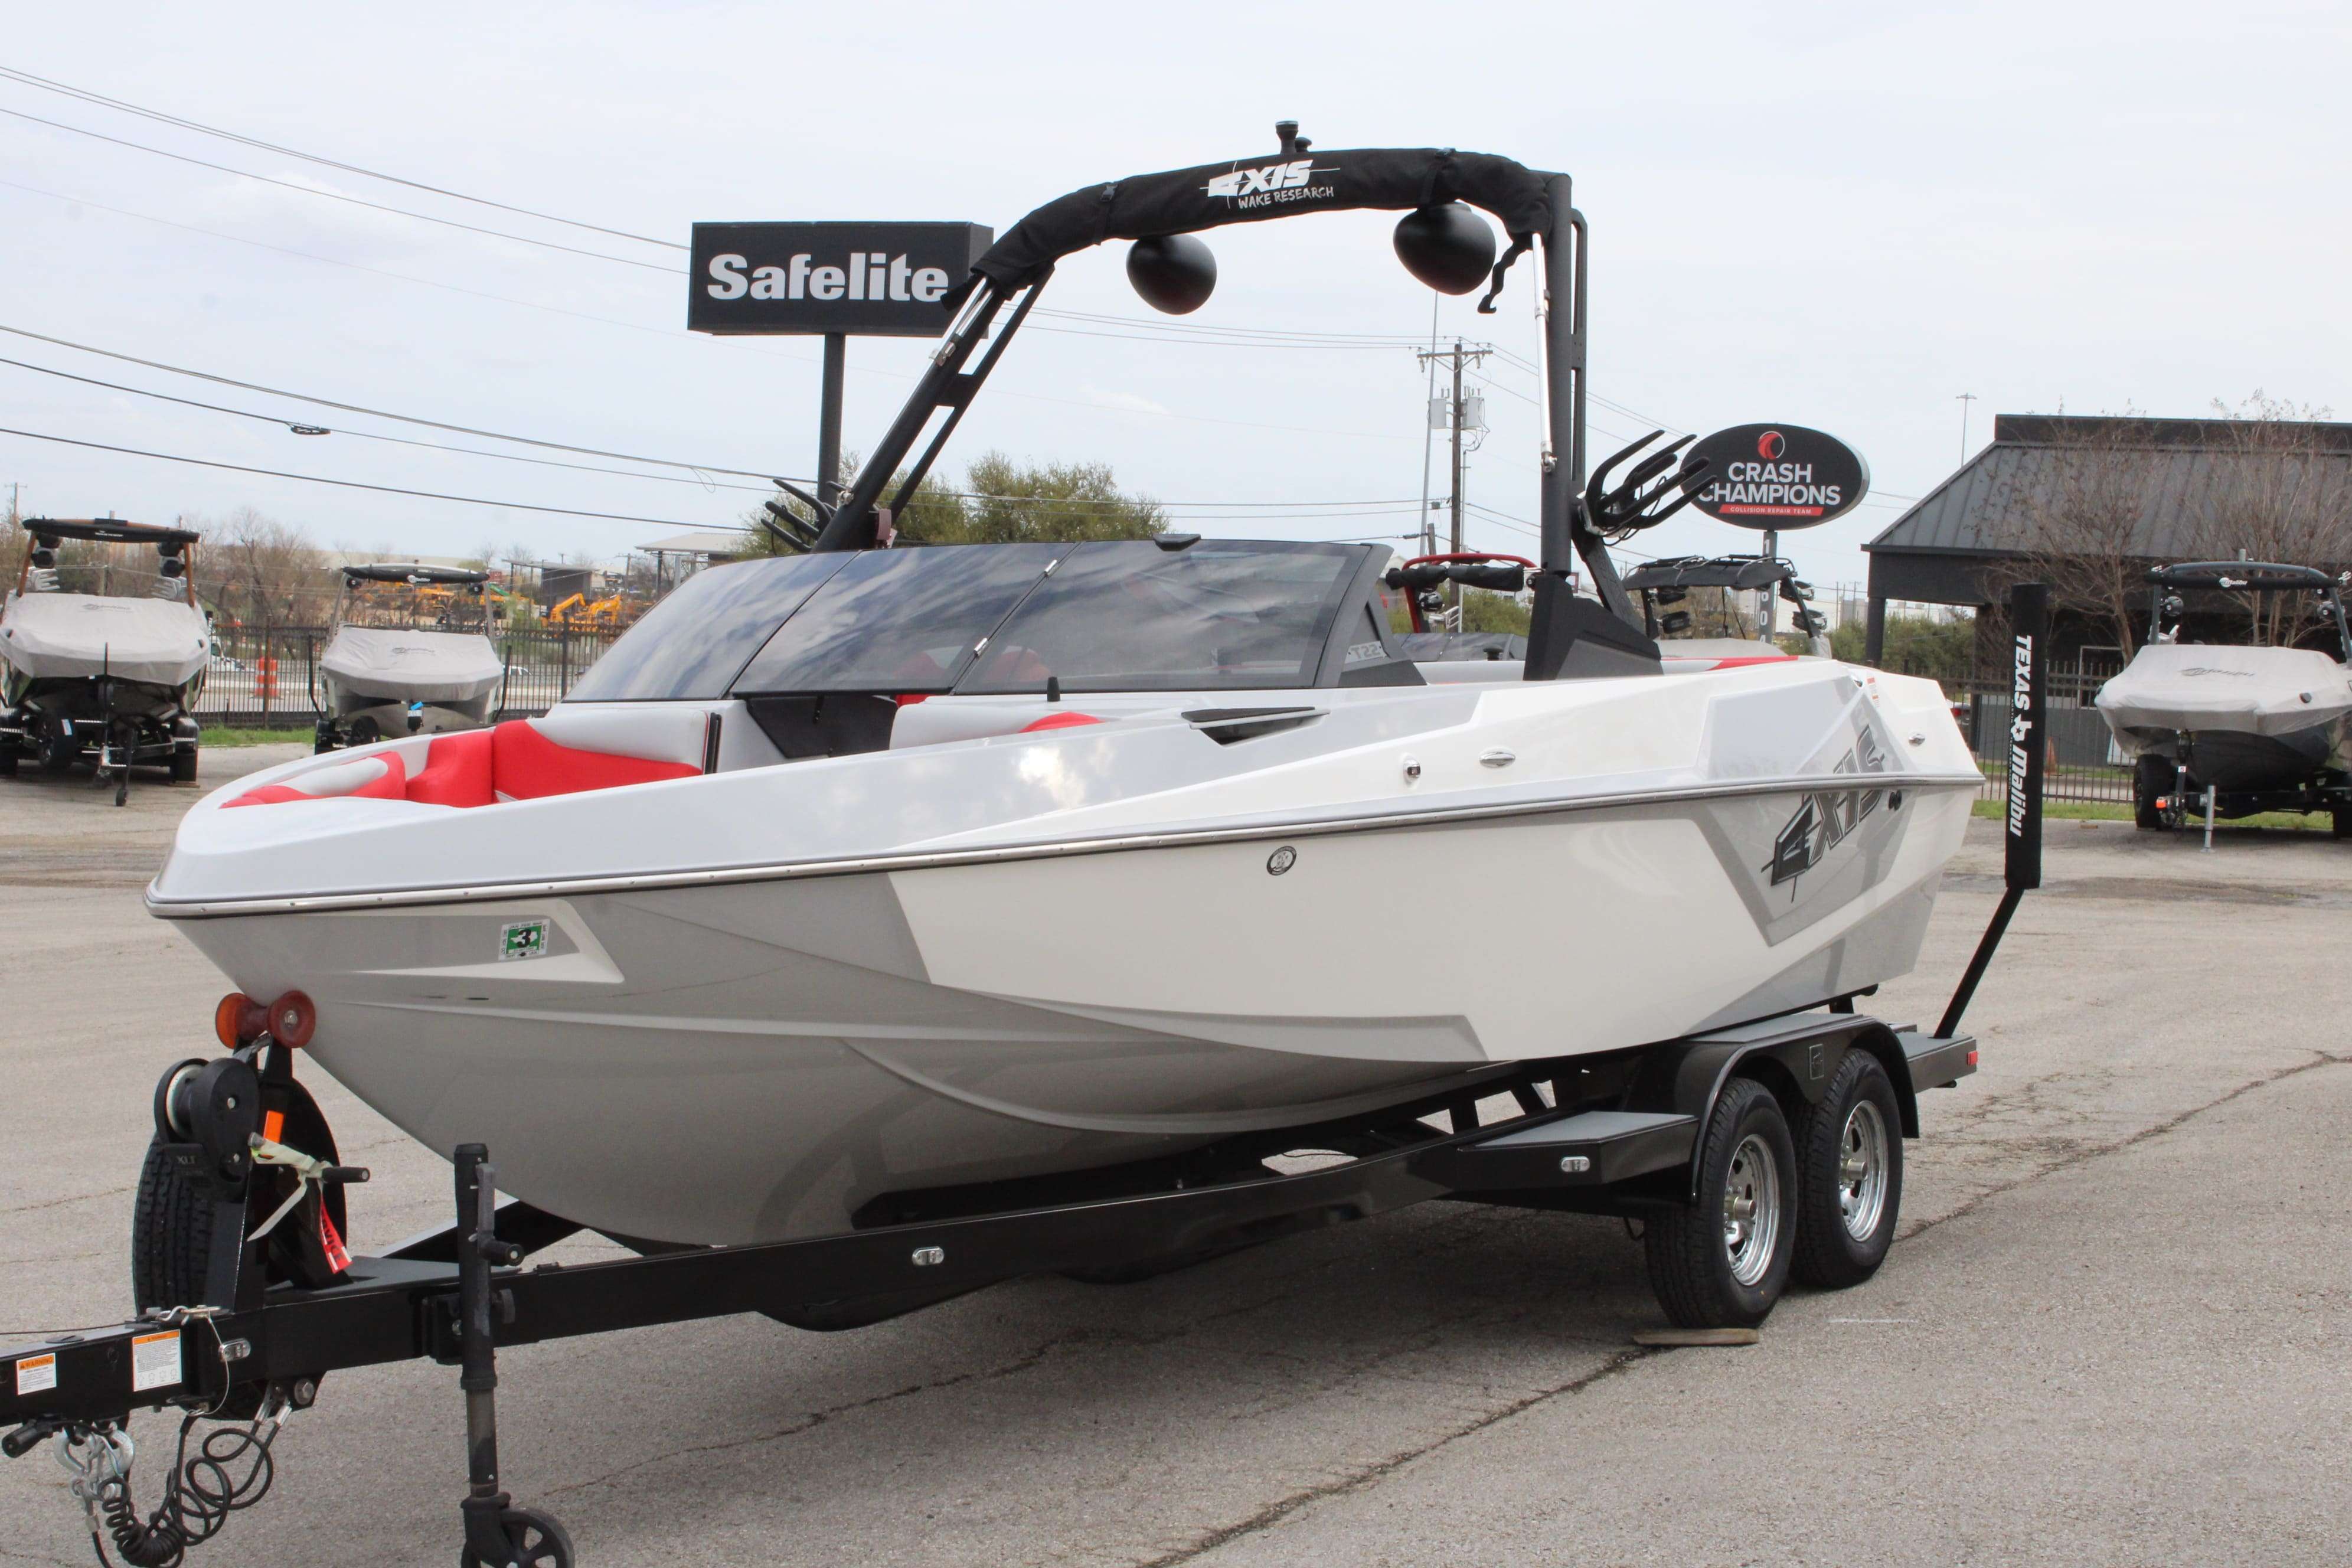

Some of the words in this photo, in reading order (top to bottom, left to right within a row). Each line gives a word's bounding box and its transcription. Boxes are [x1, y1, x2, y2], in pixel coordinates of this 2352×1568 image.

[1238, 194, 1272, 209] WAKE
[1273, 186, 1334, 202] RESEARCH
[707, 252, 949, 302] Safelite
[1728, 462, 1812, 483] CRASH
[1697, 483, 1841, 505] CHAMPIONS
[2014, 635, 2031, 710] TEXAS
[2010, 744, 2027, 837] Malibu
[517, 929, 532, 948] 3
